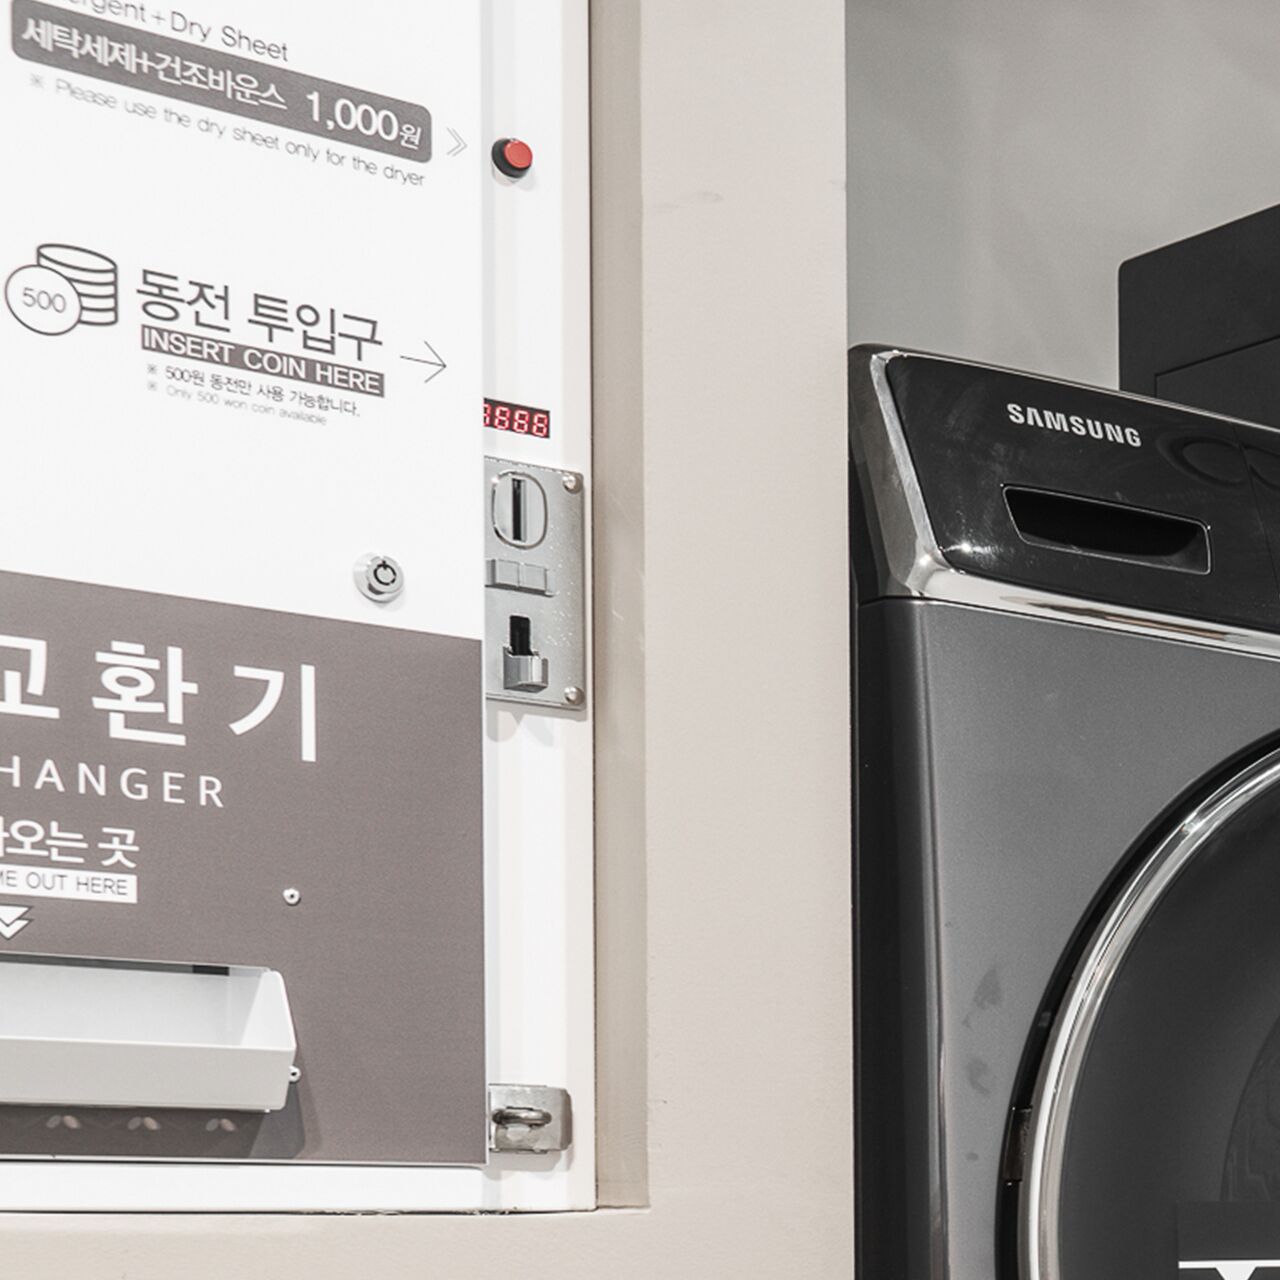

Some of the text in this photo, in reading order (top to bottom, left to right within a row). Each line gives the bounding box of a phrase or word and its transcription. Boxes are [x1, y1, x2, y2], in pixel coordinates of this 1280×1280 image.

[221, 25, 289, 62] Sheet
[55, 77, 426, 188] Please use the dry sheet only for the dryer
[306, 91, 421, 150] 1,000원
[22, 287, 67, 314] 500
[136, 268, 384, 362] 동전 투입구
[143, 327, 381, 394] INSERT COIN HERE
[1006, 402, 1143, 450] SAMSUNG
[97, 826, 140, 869] 곳
[26, 871, 68, 891] OUT
[76, 876, 129, 896] HERE
